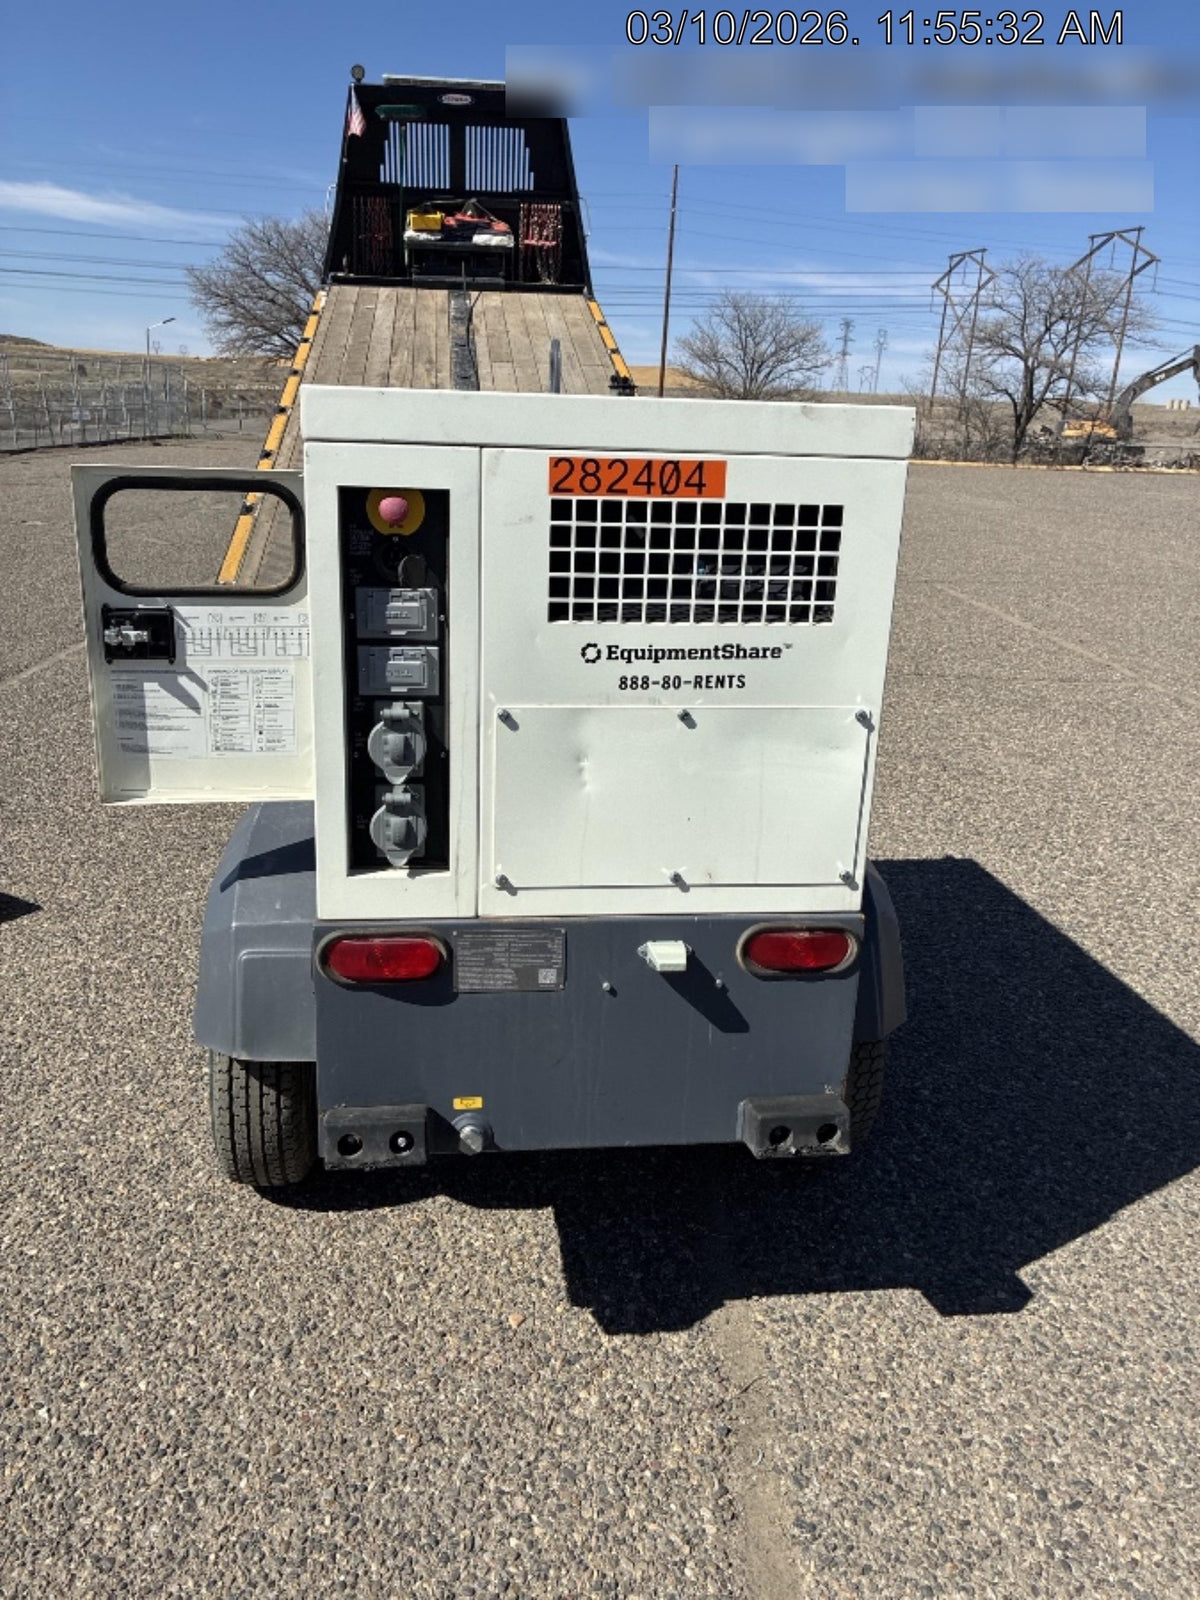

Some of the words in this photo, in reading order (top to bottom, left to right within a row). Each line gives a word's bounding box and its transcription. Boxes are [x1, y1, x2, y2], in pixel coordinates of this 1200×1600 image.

[552, 458, 707, 495] 282404
[606, 644, 783, 663] EquipmentShare
[618, 675, 746, 690] 888-80-RENTS
